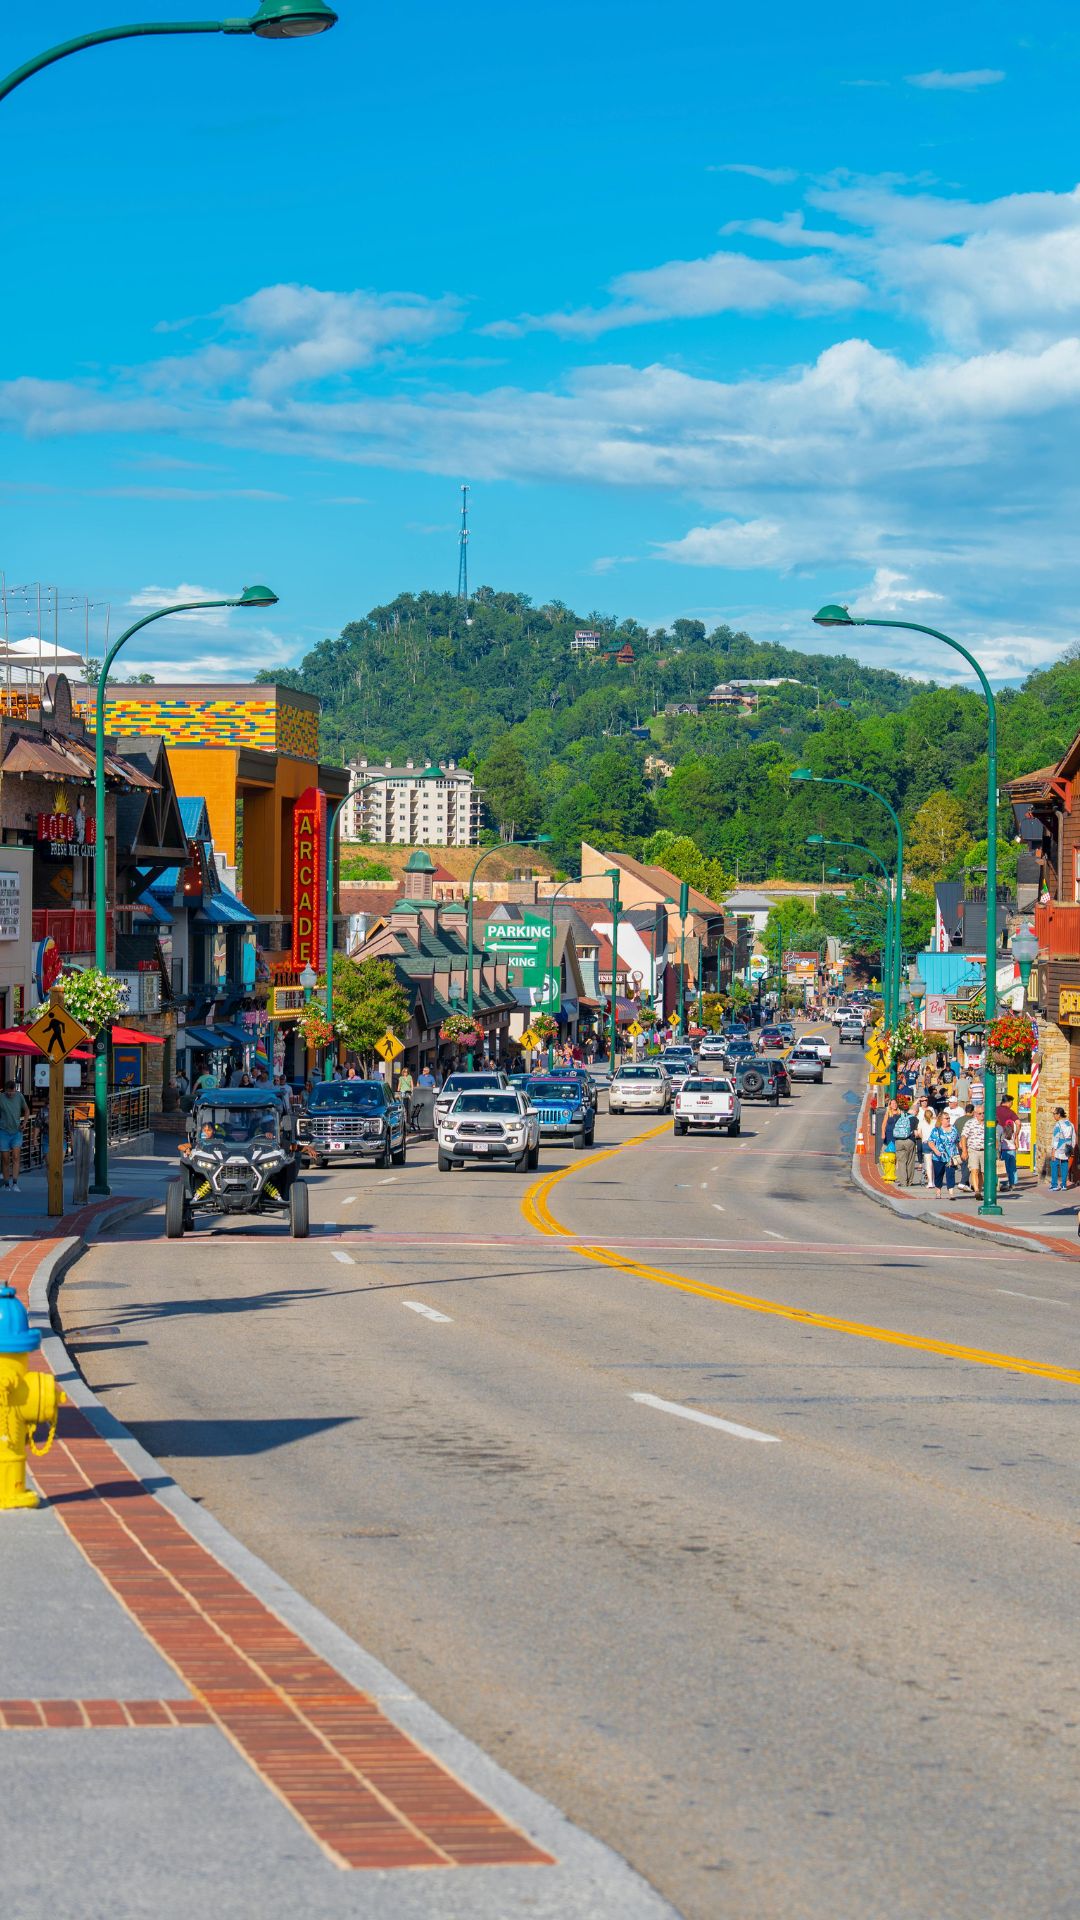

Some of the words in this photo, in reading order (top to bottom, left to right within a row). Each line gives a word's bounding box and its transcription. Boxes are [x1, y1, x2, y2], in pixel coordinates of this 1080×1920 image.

[299, 815, 312, 961] ARCADE
[487, 926, 550, 938] PARKING
[508, 957, 536, 967] KING
